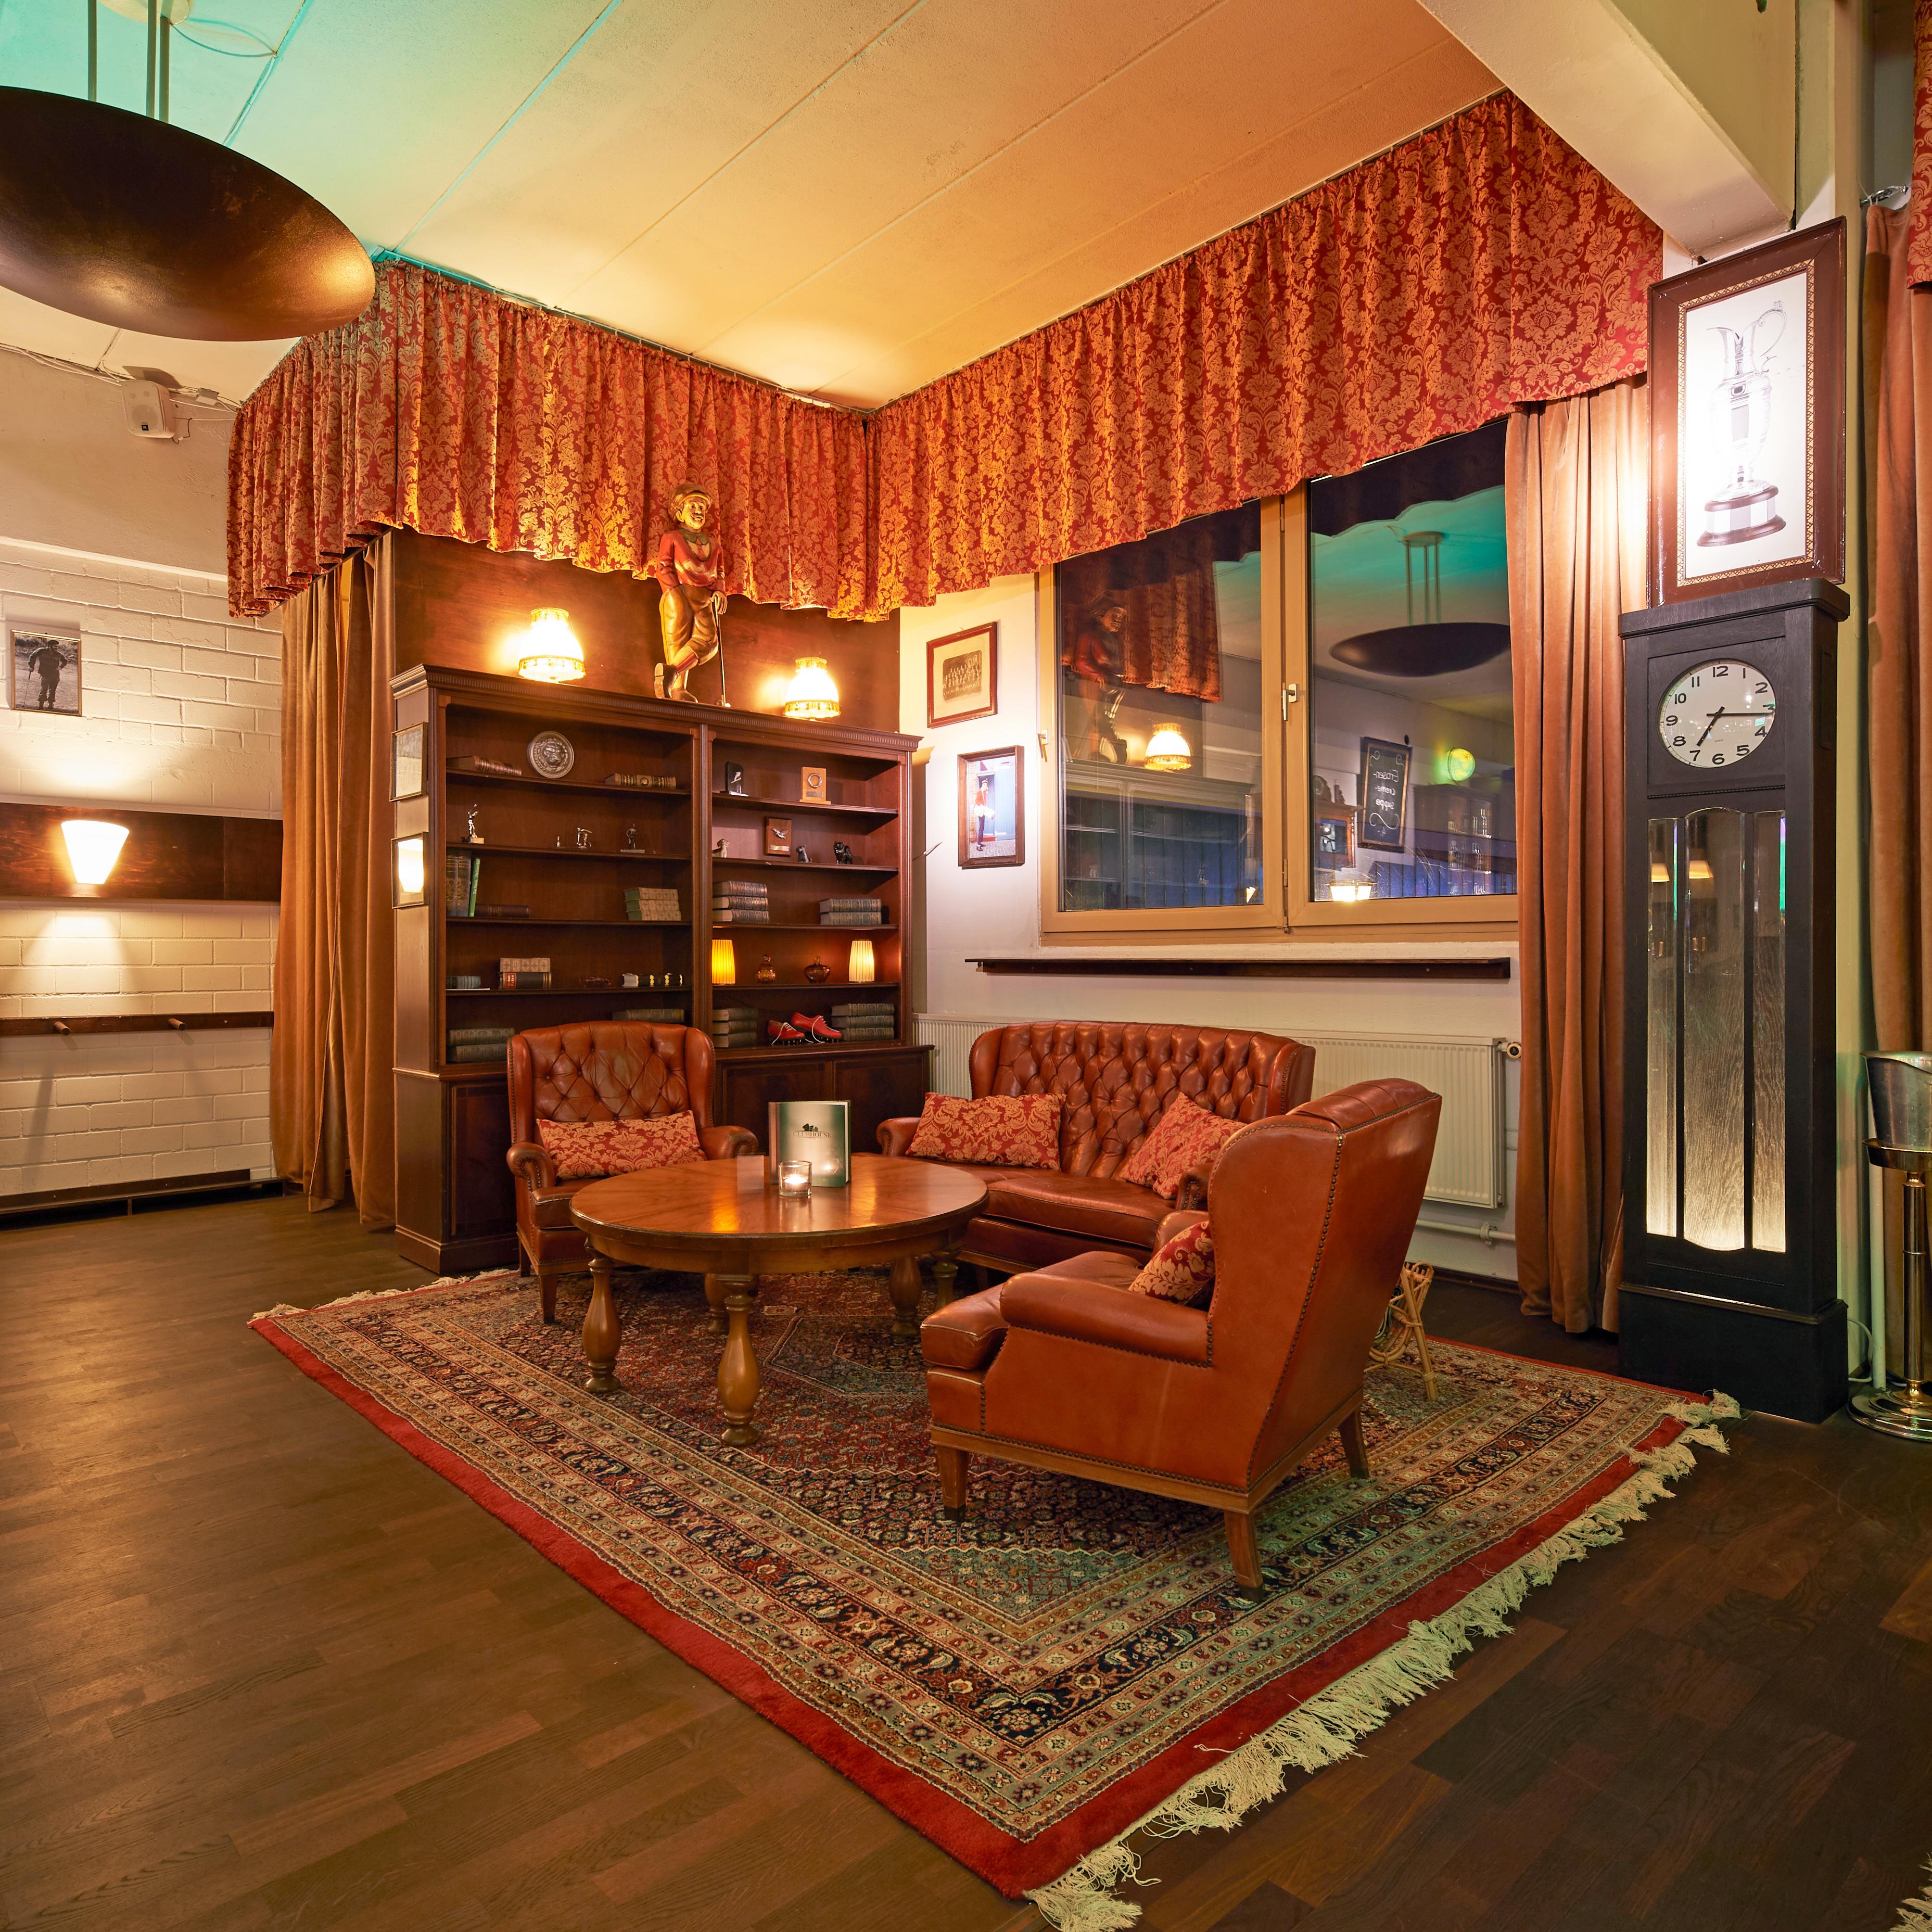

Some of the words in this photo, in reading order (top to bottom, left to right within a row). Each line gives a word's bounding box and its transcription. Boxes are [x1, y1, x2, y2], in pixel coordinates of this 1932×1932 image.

[1712, 665, 1728, 678] 12
[1743, 667, 1746, 679] 1
[1692, 676, 1700, 688] 11
[1755, 682, 1768, 694] 2
[1674, 693, 1687, 704] 10
[1666, 715, 1678, 726] 9
[1755, 726, 1768, 737] 4
[1672, 735, 1686, 746] 8
[1689, 749, 1701, 761] 7
[1736, 744, 1750, 756] 5
[1712, 753, 1725, 765] 6
